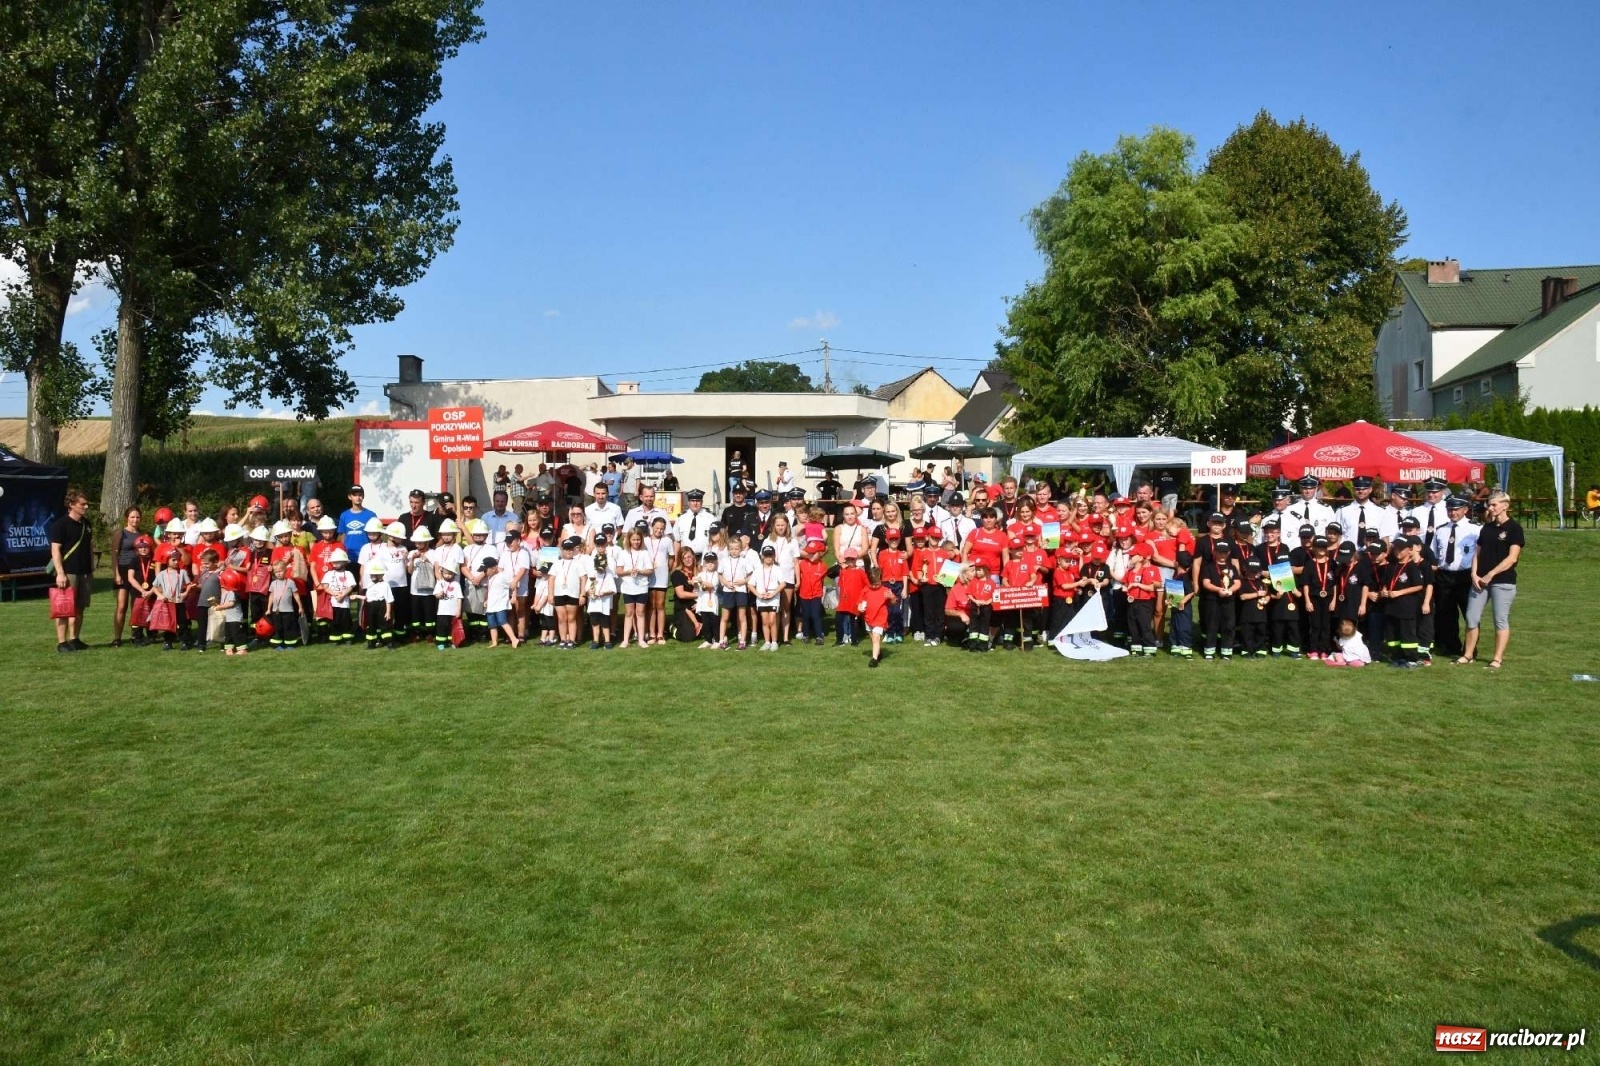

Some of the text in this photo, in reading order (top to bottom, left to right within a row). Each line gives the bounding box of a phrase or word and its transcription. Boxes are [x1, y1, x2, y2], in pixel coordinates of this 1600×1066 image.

[442, 410, 467, 421] OSP
[430, 421, 482, 432] POKRZYWNICA
[433, 434, 455, 443] Gmina
[498, 440, 540, 448] RACIBORSKIE
[442, 444, 472, 455] Opolskie
[551, 441, 596, 450] RACIBORSKIE
[1210, 455, 1227, 464] OSP
[249, 466, 316, 479] OSP GAMÓW
[1193, 467, 1243, 477] PIETRASZYN
[1304, 466, 1355, 479] RACIBORSKIE
[1399, 469, 1447, 481] RACIBORSKIE
[8, 524, 46, 538] ŚWIETNA
[6, 537, 50, 549] TELEWIZJA
